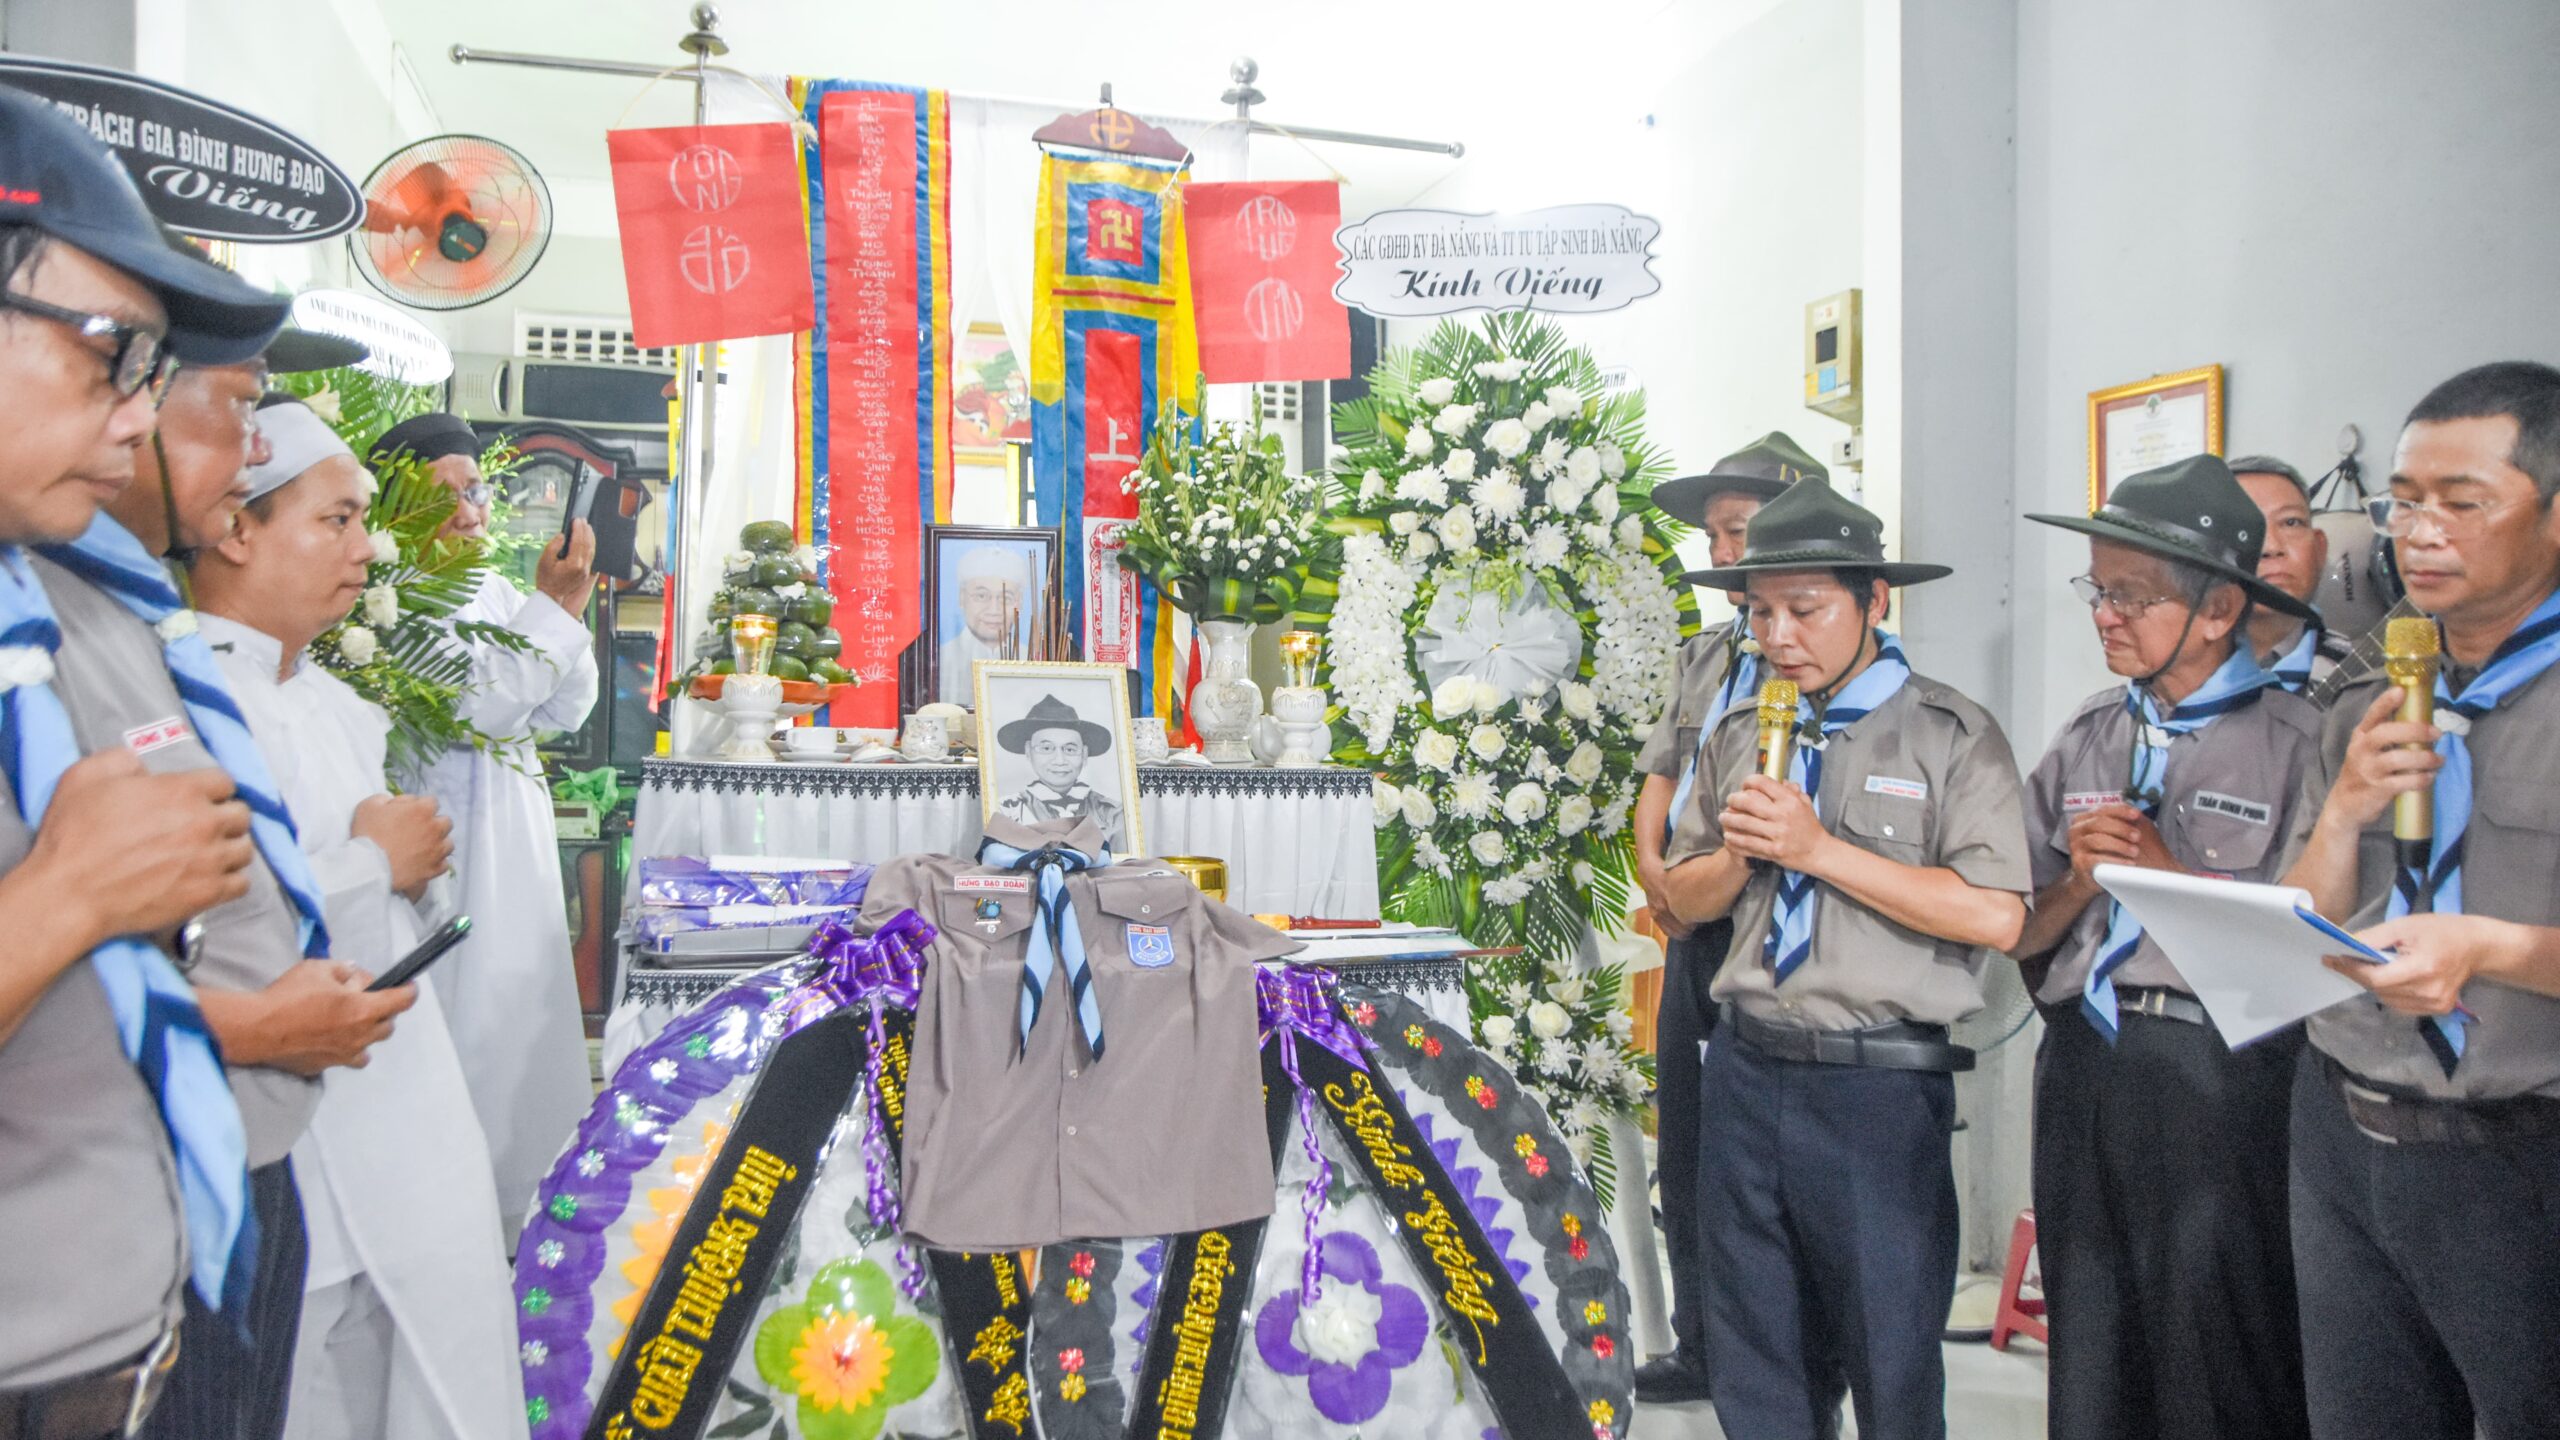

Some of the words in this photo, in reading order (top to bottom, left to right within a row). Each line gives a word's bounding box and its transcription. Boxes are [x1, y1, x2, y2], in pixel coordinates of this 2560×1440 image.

[140, 120, 175, 158] GIA
[179, 128, 227, 172] ĐÌNH
[289, 161, 325, 200] ĐẠO
[146, 165, 320, 230] Viếng
[1354, 229, 1376, 261] CÁC
[1413, 233, 1430, 259] KV
[1432, 226, 1447, 258] ĐÀ
[1483, 224, 1499, 257] VÀ
[1501, 231, 1516, 256] TT
[1561, 229, 1589, 255] SINH
[1591, 222, 1607, 254] ĐÀ
[1390, 268, 1482, 299] Kính
[1494, 265, 1604, 301] Viếng
[1088, 416, 1141, 466] 上
[957, 879, 980, 889] HƯNG
[983, 880, 1000, 890] ĐẠO
[721, 1144, 798, 1220] PHỤ
[1324, 1071, 1425, 1191] Kính
[1405, 1189, 1499, 1367] Viếng
